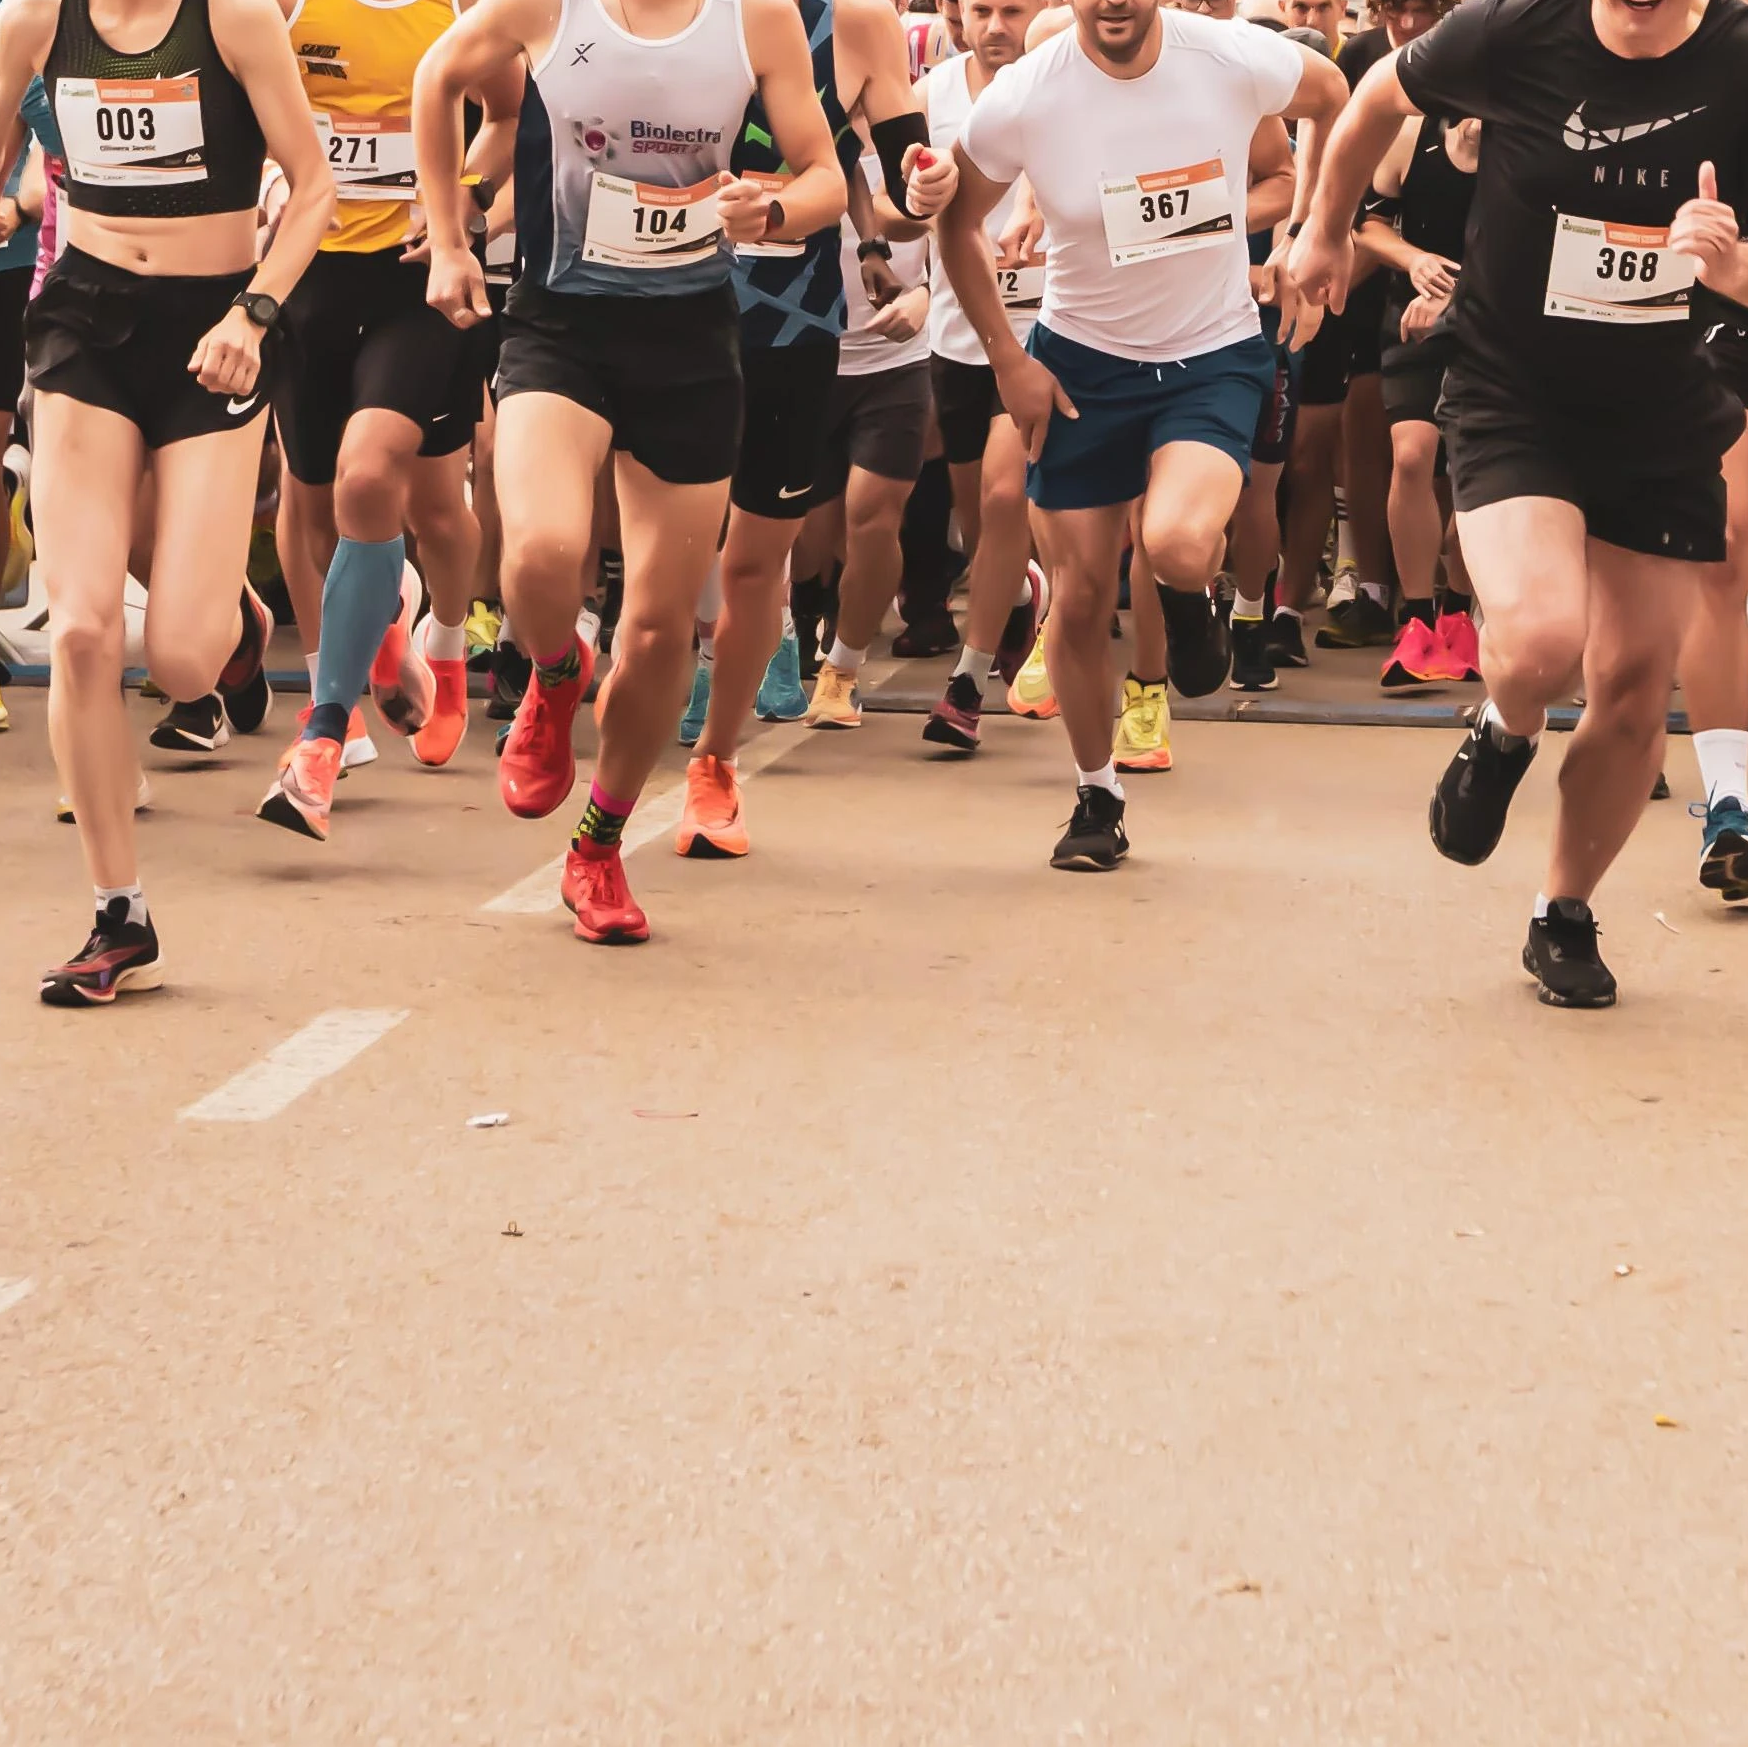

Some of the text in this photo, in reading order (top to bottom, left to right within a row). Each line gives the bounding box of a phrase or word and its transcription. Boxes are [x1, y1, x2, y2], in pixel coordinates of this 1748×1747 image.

[96, 107, 156, 141] 003
[630, 120, 721, 144] Biolectra
[328, 136, 379, 164] 271
[1594, 166, 1670, 189] NIKE
[1139, 189, 1191, 224] 367
[633, 207, 687, 235] 104
[1596, 247, 1659, 284] 368
